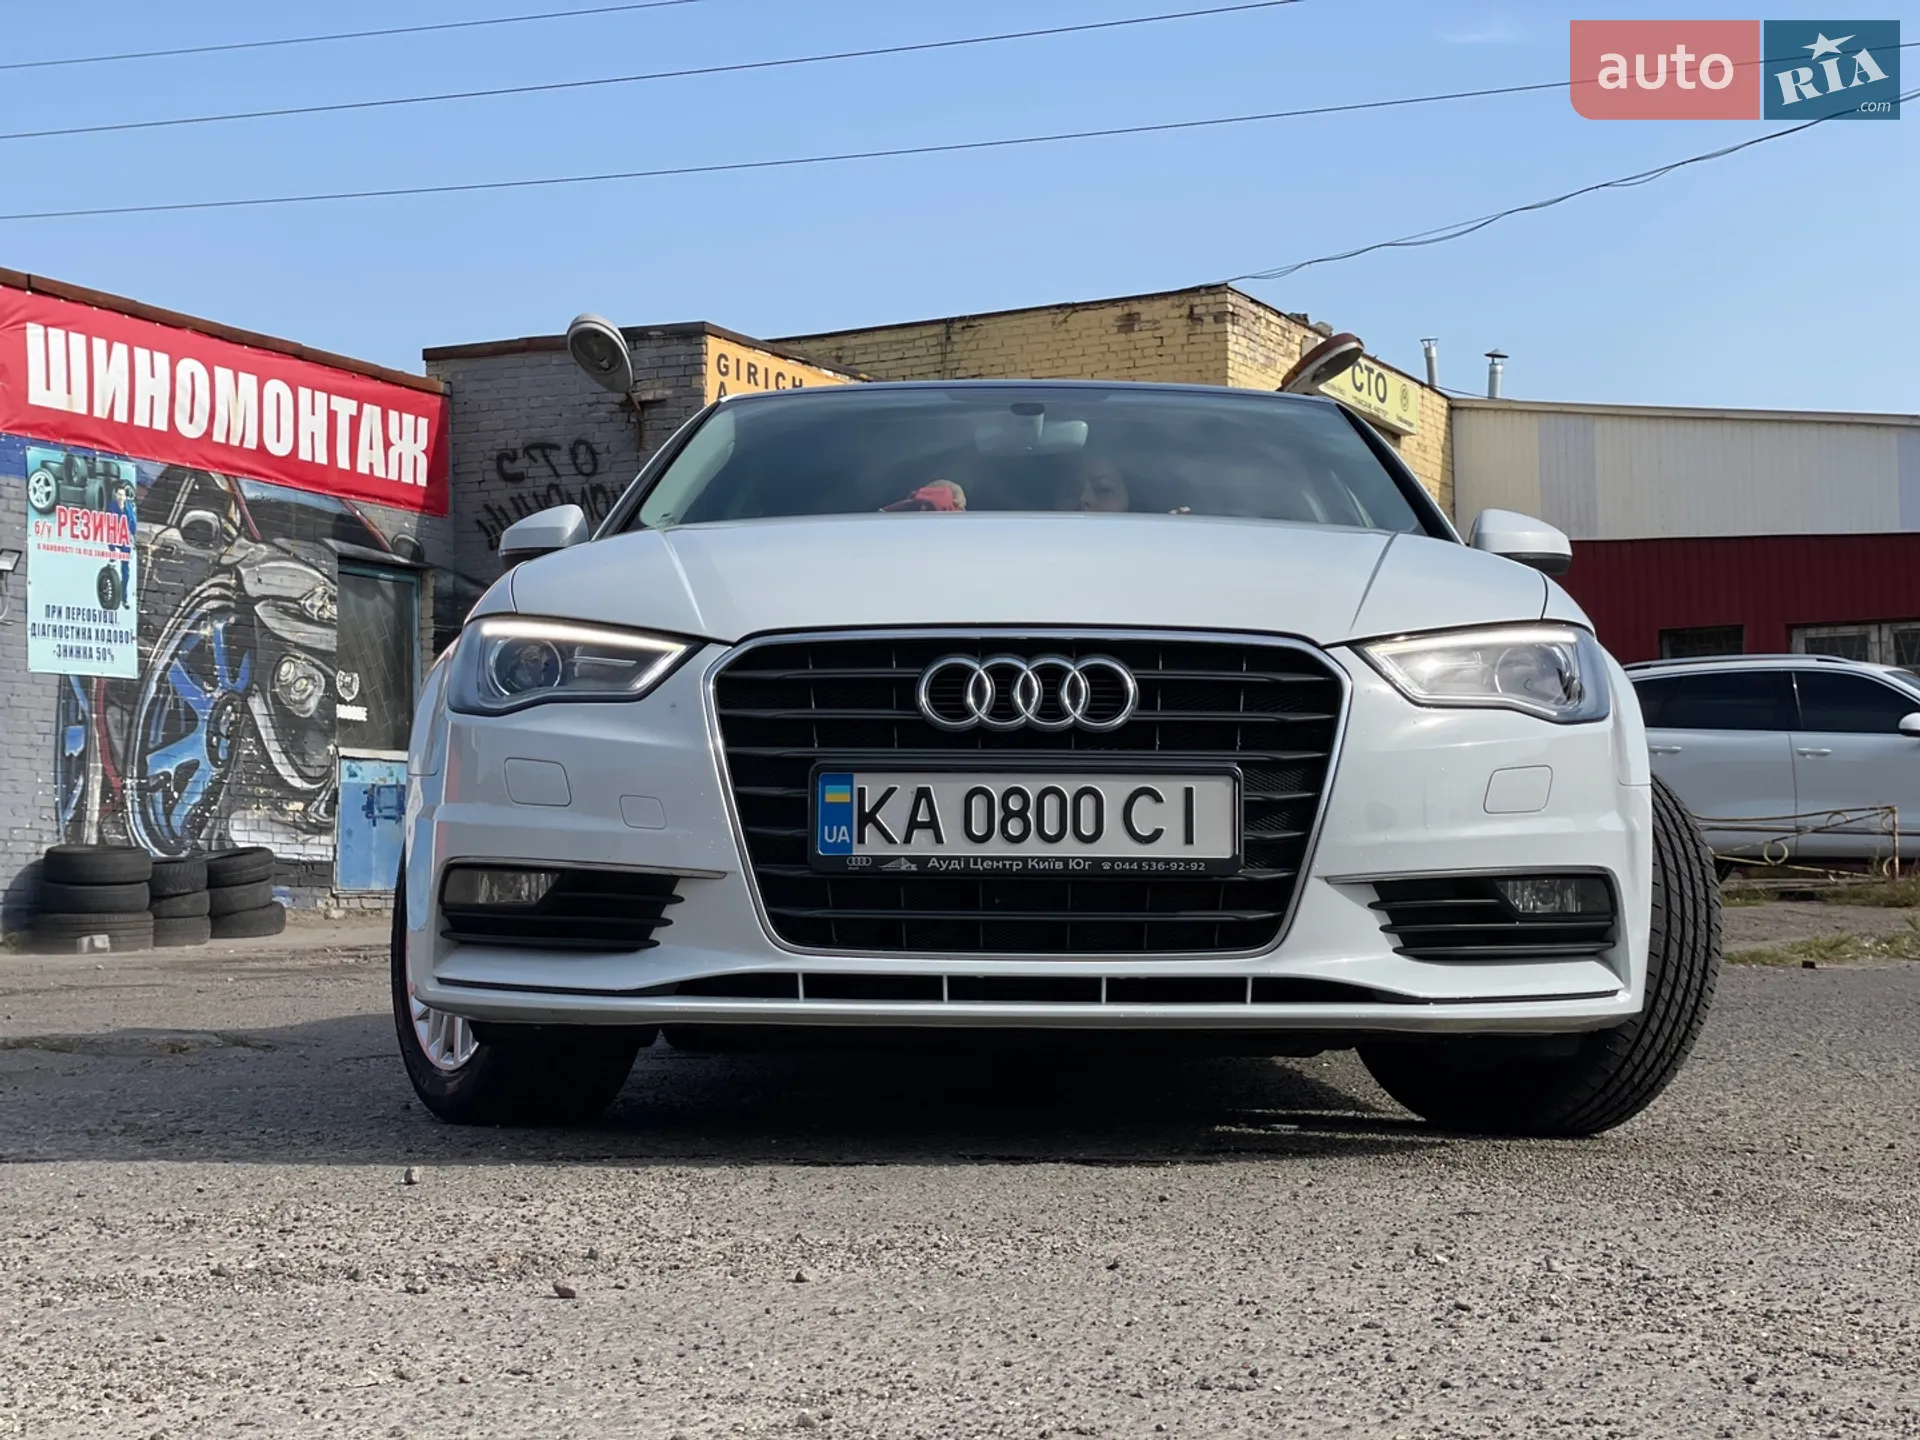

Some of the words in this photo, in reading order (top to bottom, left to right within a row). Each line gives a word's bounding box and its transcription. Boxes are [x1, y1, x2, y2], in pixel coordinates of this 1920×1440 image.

[1352, 361, 1387, 403] СТО
[26, 322, 429, 487] ШИНОМОНТАЖ
[496, 439, 598, 482] СТО
[56, 505, 130, 545] РЕЗИНА
[45, 604, 62, 619] ПРИ
[30, 622, 92, 641] ДІАГНОСТИКА
[95, 647, 115, 663] 50%
[856, 786, 946, 846] KA
[963, 785, 1105, 845] 0800
[1122, 786, 1196, 846] CI
[824, 825, 850, 844] UA
[927, 857, 965, 871] Ауді
[969, 857, 1023, 871] Центр
[1027, 858, 1064, 871] Київ
[1068, 858, 1093, 871] Юг
[1114, 862, 1138, 871] 044
[1141, 862, 1206, 871] 536-92-92
